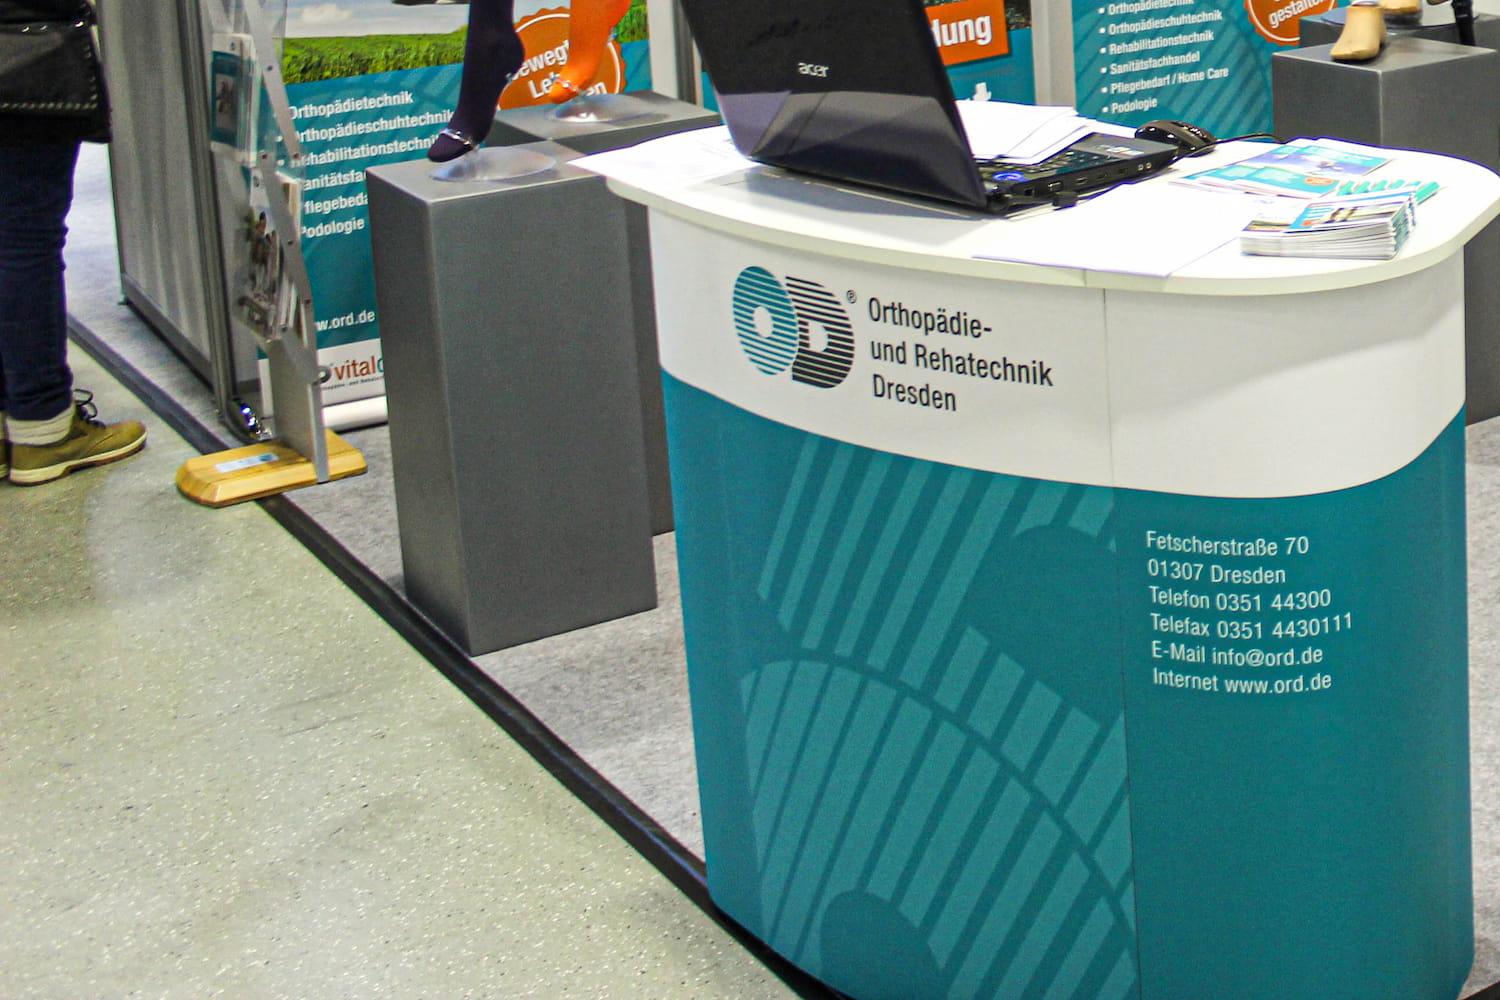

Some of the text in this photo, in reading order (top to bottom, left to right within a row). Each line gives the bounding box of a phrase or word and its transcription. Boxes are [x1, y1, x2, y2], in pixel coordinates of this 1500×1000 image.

[1109, 10, 1222, 35] Orthopädieschuhtechnik
[1109, 30, 1214, 54] Rehabilitationstechnik
[798, 61, 829, 78] acer
[1110, 51, 1200, 74] Sanitätsfachhandel
[1110, 74, 1170, 95] Pflegebedarf
[1178, 70, 1204, 84] Home
[1207, 67, 1229, 80] Care
[289, 91, 414, 120] Orthopädietechnik
[1111, 97, 1157, 114] Podologie
[296, 110, 454, 143] rthopädieschuhtechnik
[304, 170, 366, 191] anitätsfa
[868, 297, 992, 339] Orthopädie-
[871, 341, 1053, 386] und Rehatechnik
[873, 374, 956, 411] Dresden
[1146, 530, 1309, 556] Fetscherstraße 70
[1147, 559, 1286, 584] 01307 Dresden
[1148, 586, 1332, 612] Telefon 0351 44300
[1150, 612, 1352, 639] Telefax 0351 4430111
[1152, 640, 1323, 667] E-Mail info@ord.de
[1153, 667, 1332, 694] Internet www.ord.de
